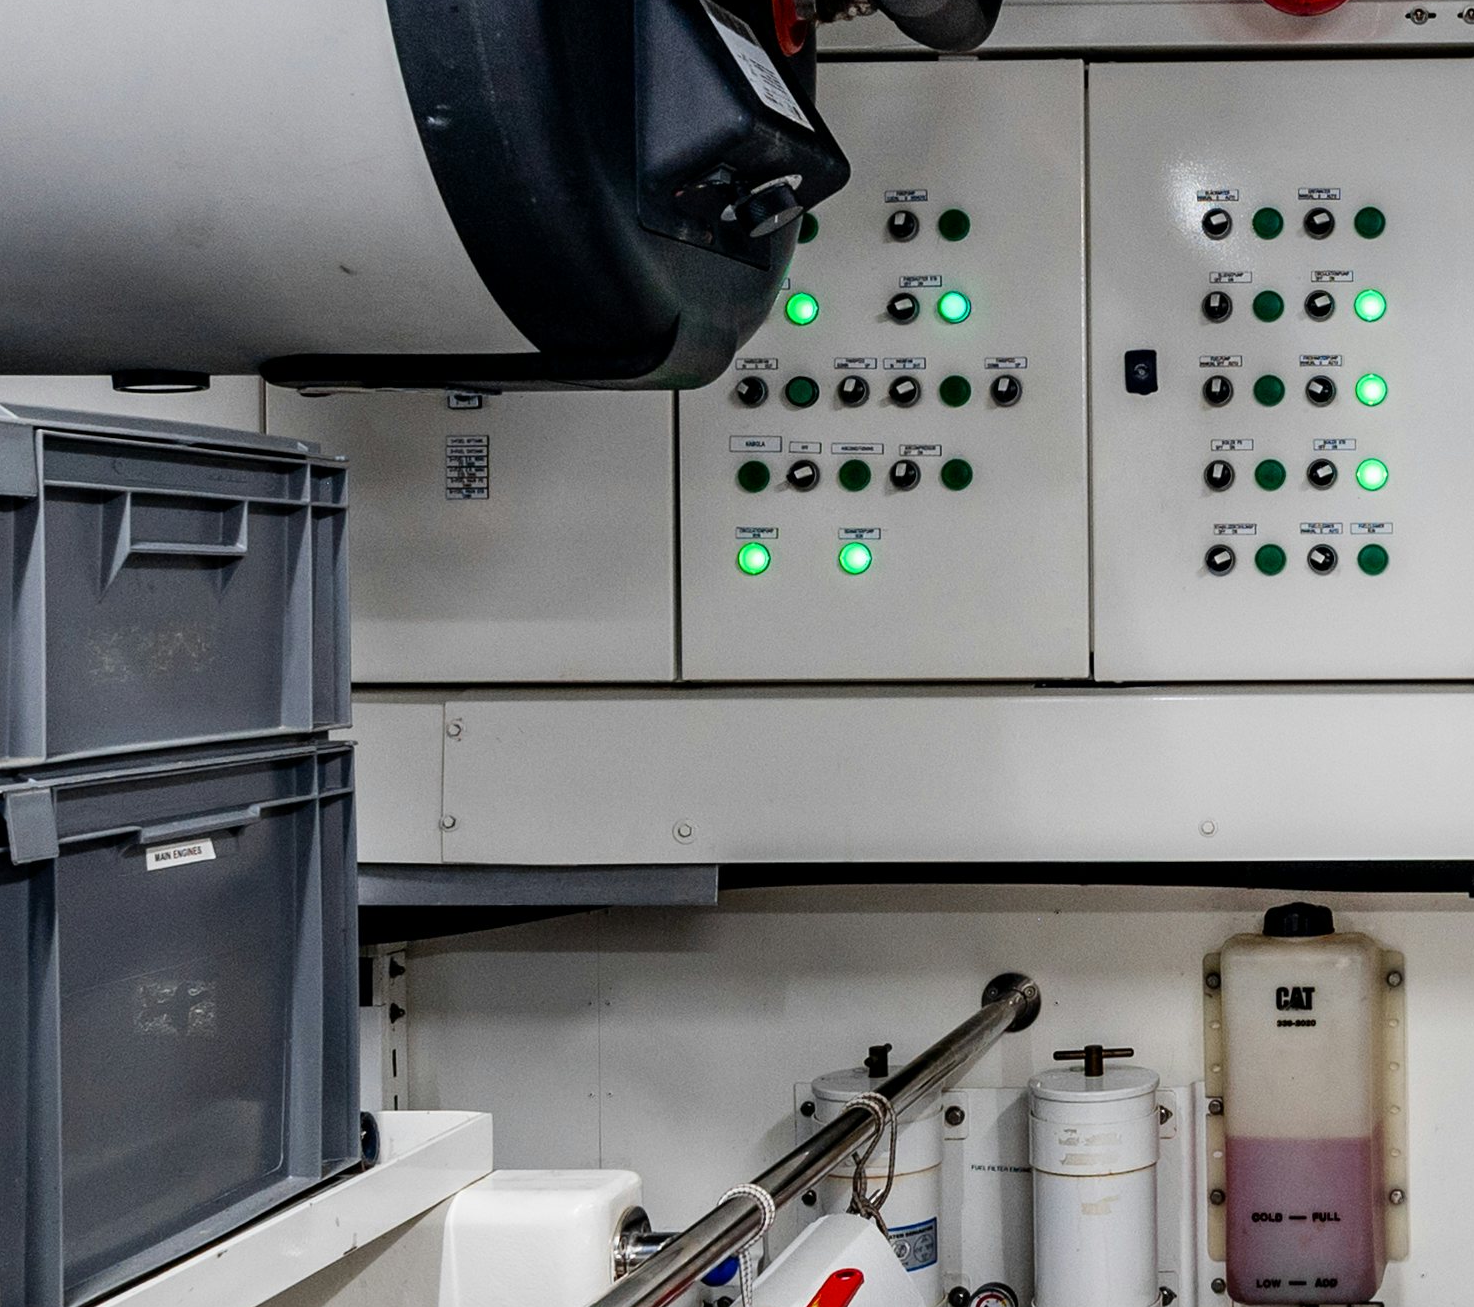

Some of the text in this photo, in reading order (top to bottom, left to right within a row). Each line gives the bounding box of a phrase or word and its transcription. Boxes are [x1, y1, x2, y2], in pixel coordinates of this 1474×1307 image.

[154, 845, 203, 862] MAIN ENGINES
[1275, 986, 1316, 1011] CAT
[1251, 1212, 1341, 1223] COLD FULL
[1256, 1278, 1338, 1289] LOW ADD
